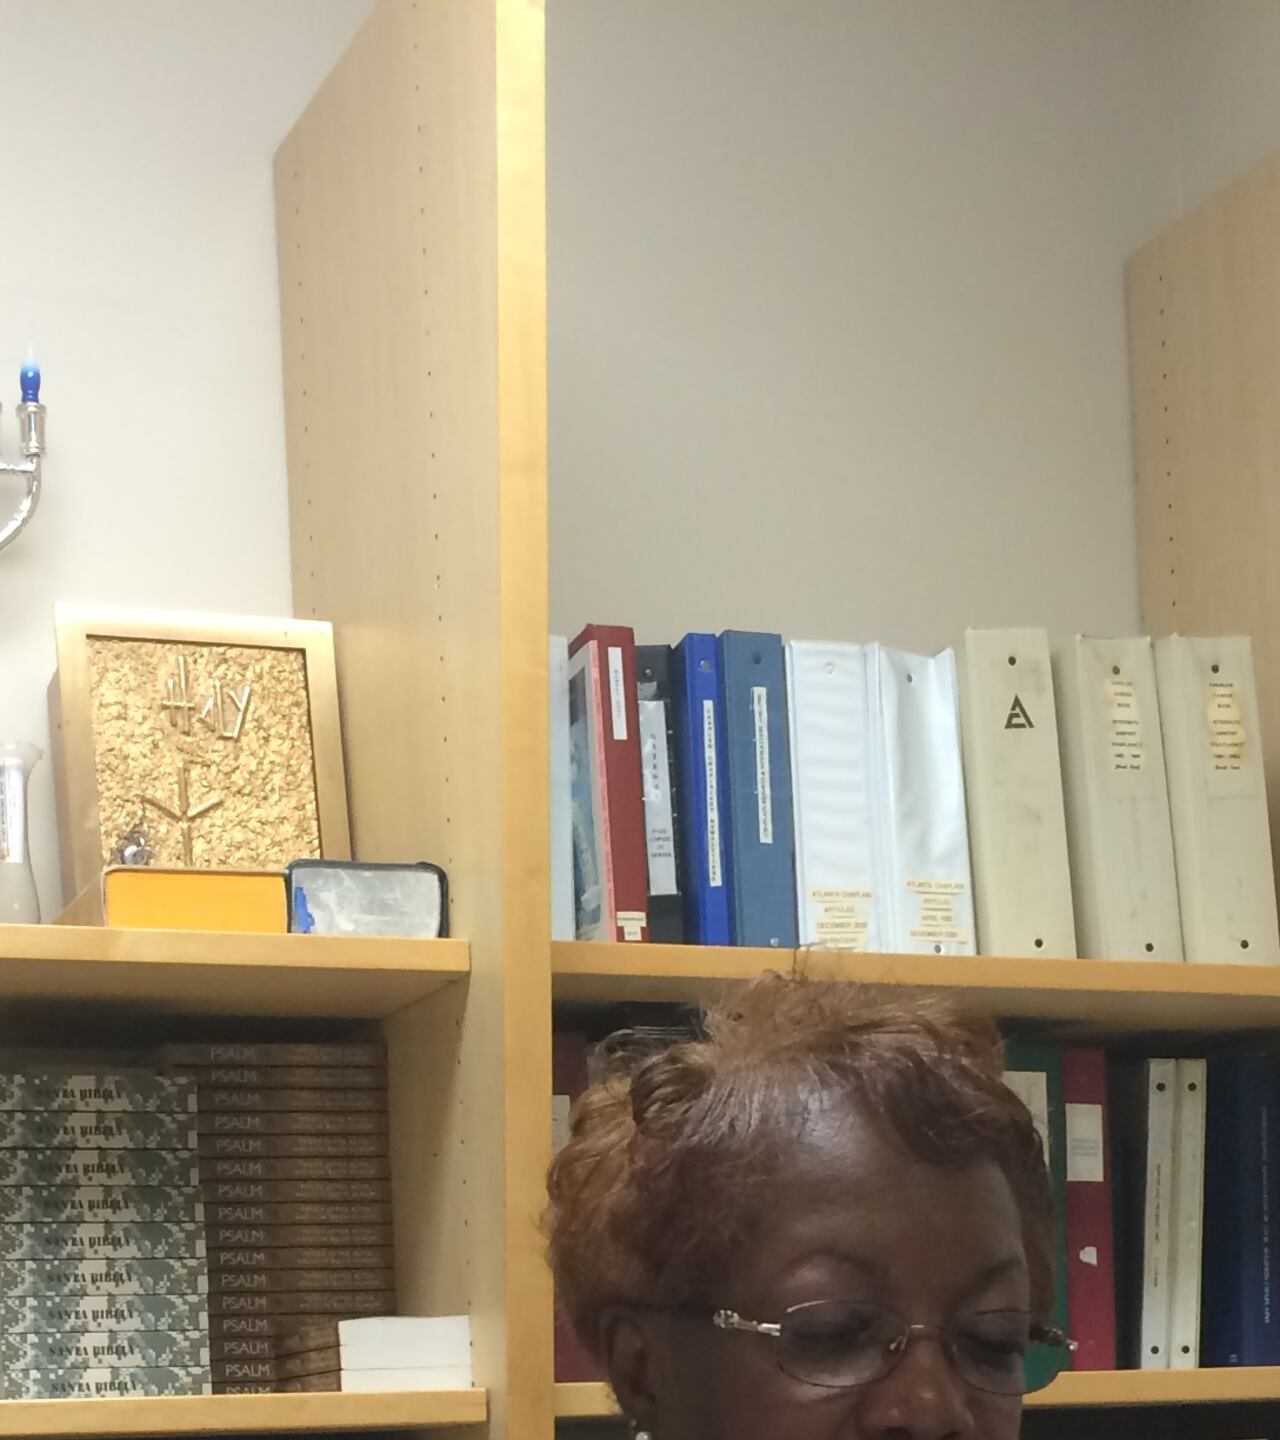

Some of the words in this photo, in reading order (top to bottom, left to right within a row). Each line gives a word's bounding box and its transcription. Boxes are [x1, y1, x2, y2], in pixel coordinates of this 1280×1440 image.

[215, 1116, 260, 1129] PSALM
[216, 1139, 262, 1152] PSALM
[217, 1163, 262, 1175] PSALM
[218, 1185, 263, 1197] PSALM
[218, 1207, 263, 1220] PSALM
[220, 1230, 264, 1242] PSALM
[220, 1252, 265, 1265] PSALM
[221, 1274, 266, 1287] PSALM
[222, 1297, 267, 1309] PSALM
[223, 1319, 268, 1332] PSALM
[224, 1342, 268, 1354] PSALM
[225, 1364, 270, 1377] PSALM
[51, 1381, 91, 1392] SANTA
